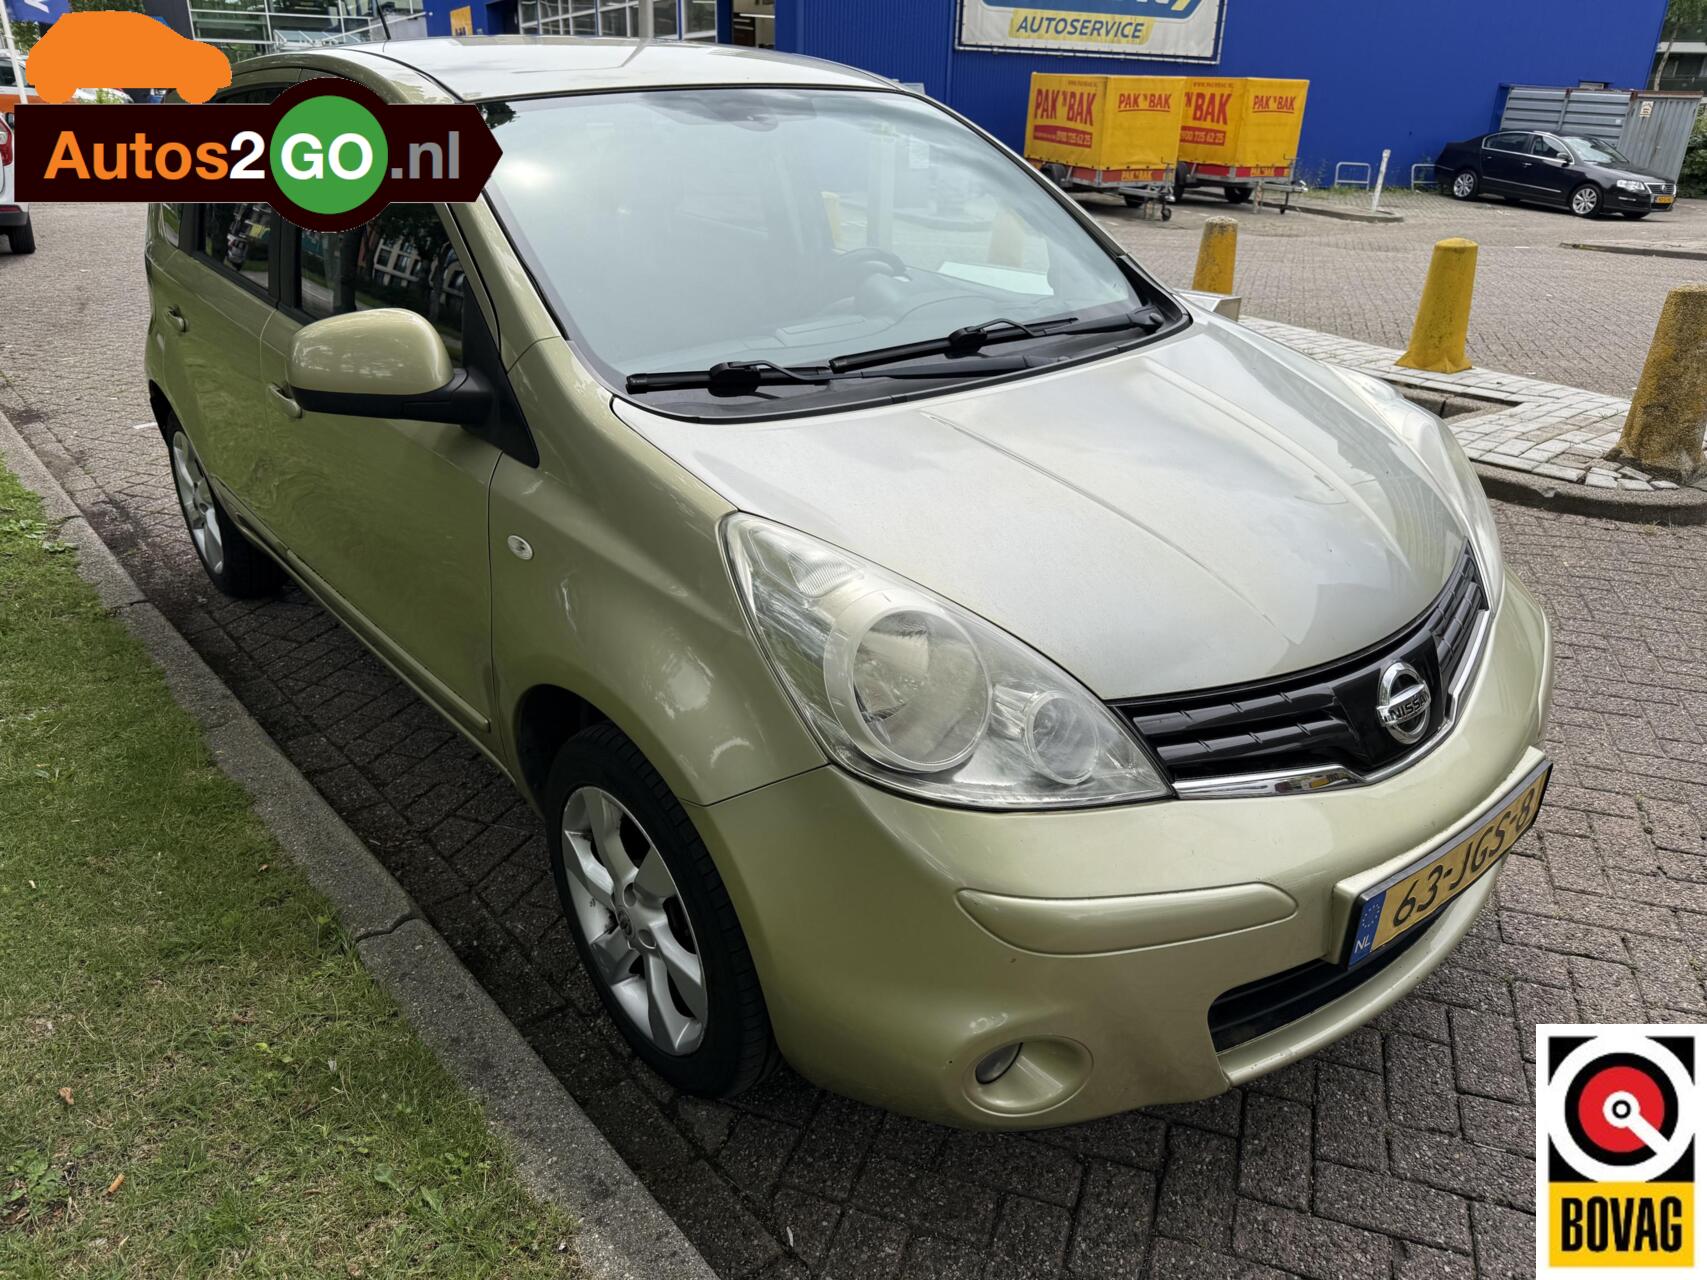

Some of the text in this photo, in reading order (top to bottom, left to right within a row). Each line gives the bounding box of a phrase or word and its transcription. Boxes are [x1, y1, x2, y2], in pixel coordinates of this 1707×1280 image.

[1016, 15, 1145, 39] AUTOSERVICE
[1034, 88, 1060, 119] PAK
[1067, 91, 1097, 126] BAK
[1118, 93, 1140, 109] PAK
[1148, 94, 1171, 109] BAK
[1192, 92, 1233, 125] BAK
[1253, 96, 1272, 110] PAK
[1276, 96, 1296, 111] BAK
[1393, 787, 1535, 928] 63-JGS-8
[1354, 935, 1371, 954] NL
